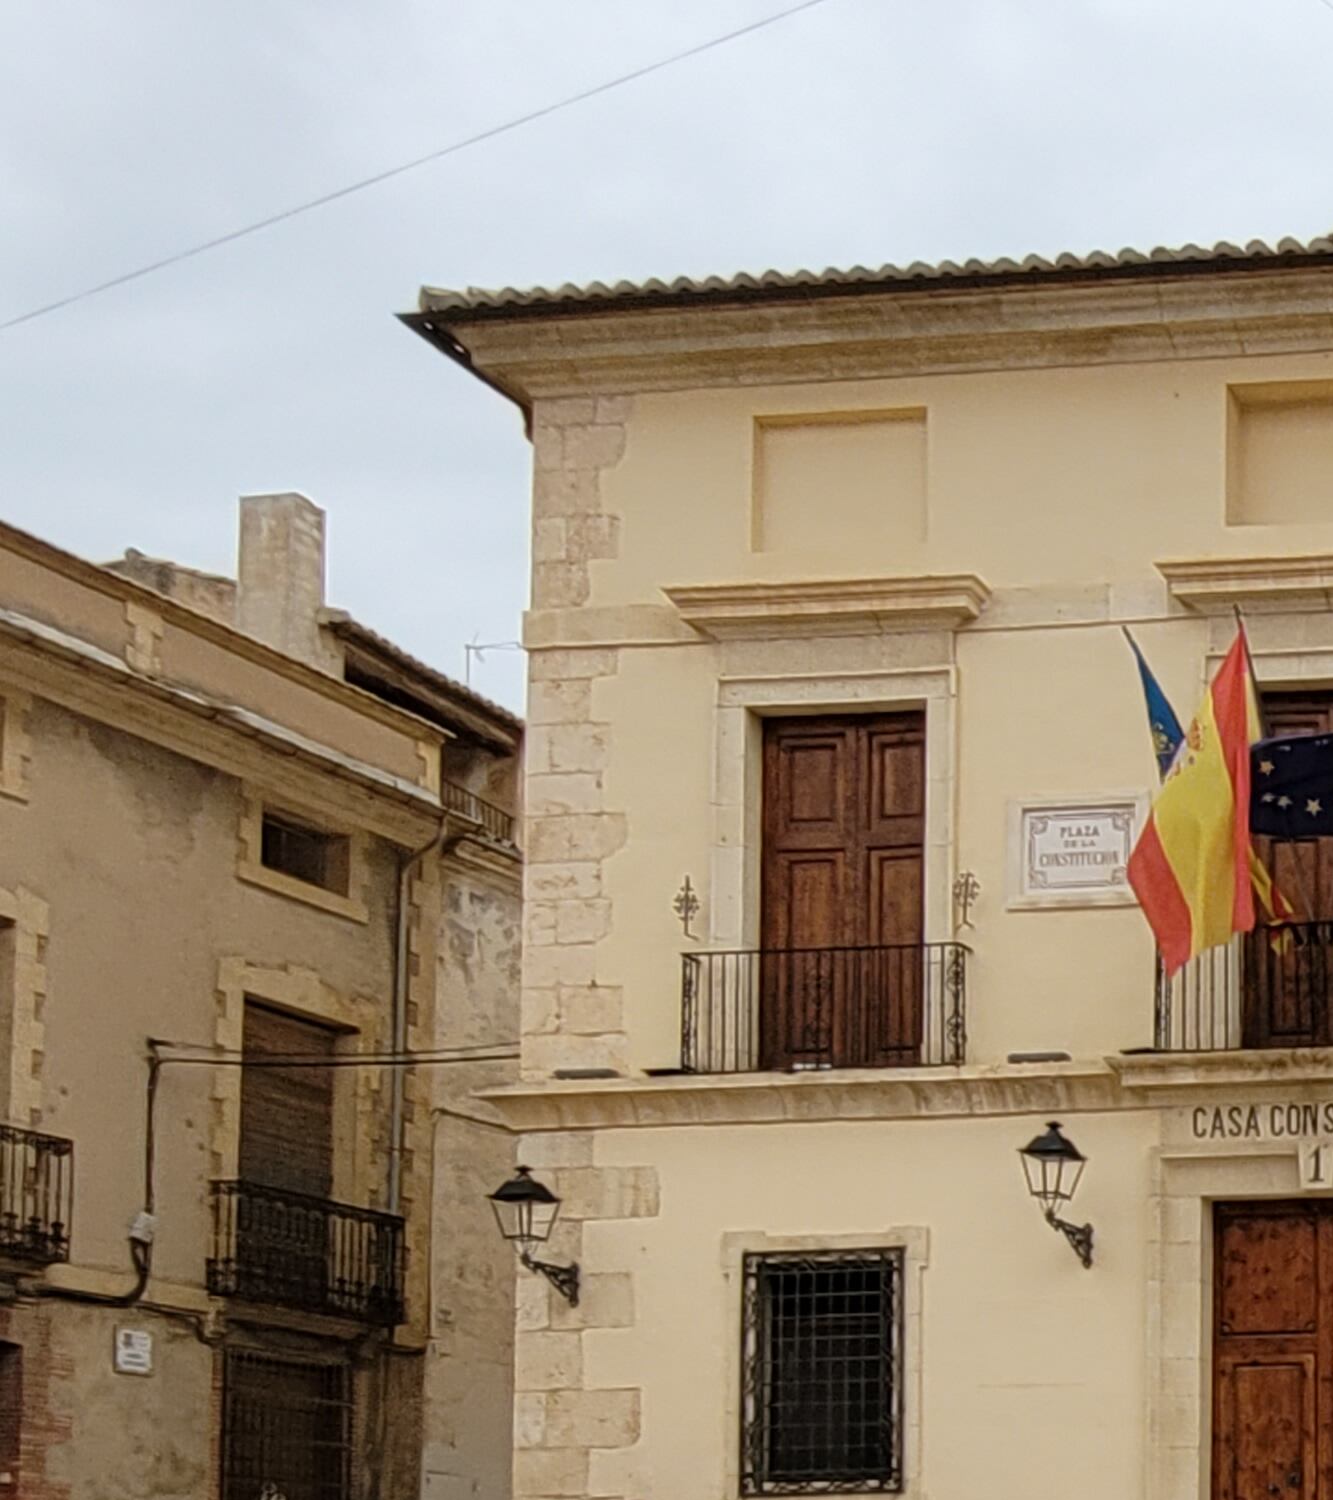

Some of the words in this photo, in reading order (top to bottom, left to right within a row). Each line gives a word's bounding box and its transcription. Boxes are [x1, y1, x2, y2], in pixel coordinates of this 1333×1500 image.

[1060, 825, 1100, 839] PLAZA
[1192, 1105, 1261, 1139] CASA
[1308, 1144, 1326, 1183] 1
